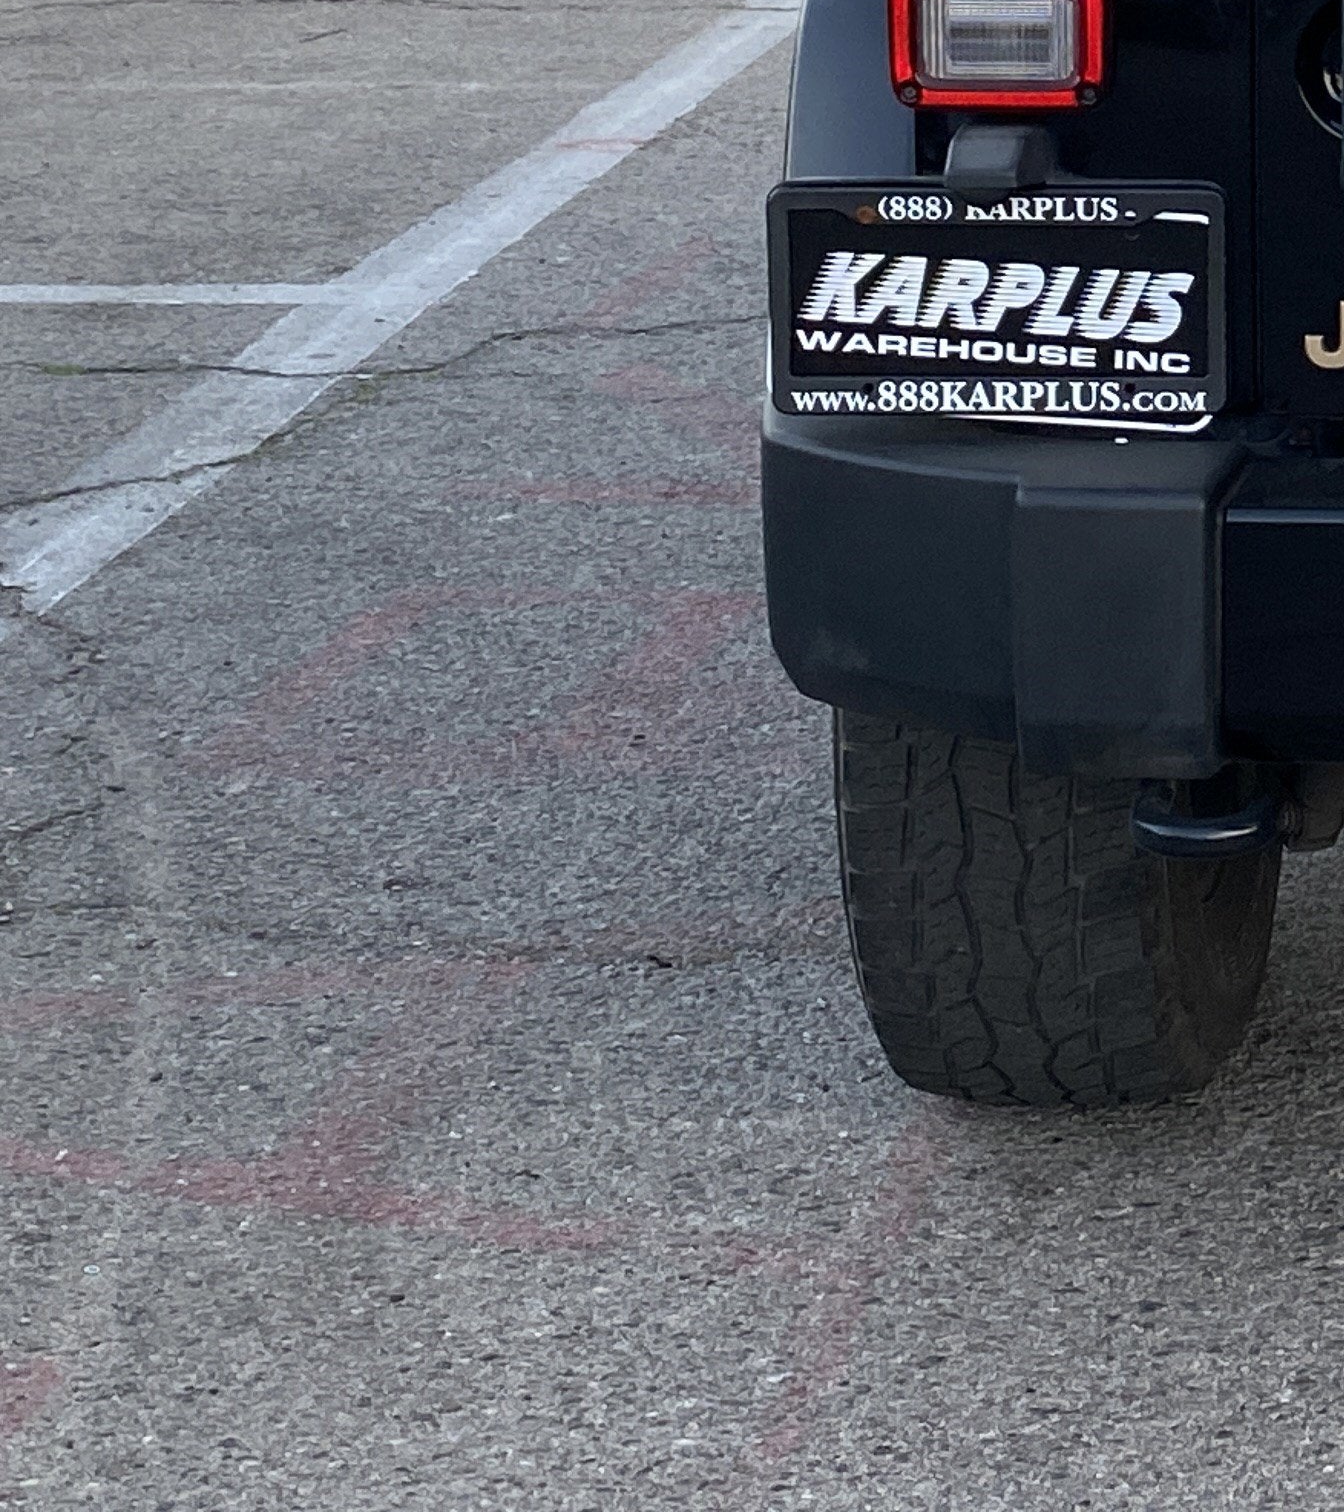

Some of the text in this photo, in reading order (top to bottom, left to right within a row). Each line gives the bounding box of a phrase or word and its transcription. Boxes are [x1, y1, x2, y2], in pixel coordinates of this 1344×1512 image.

[876, 195, 954, 222] (888)
[795, 250, 1195, 344] KARPLUS
[795, 328, 1192, 375] WAREHOUSE INC
